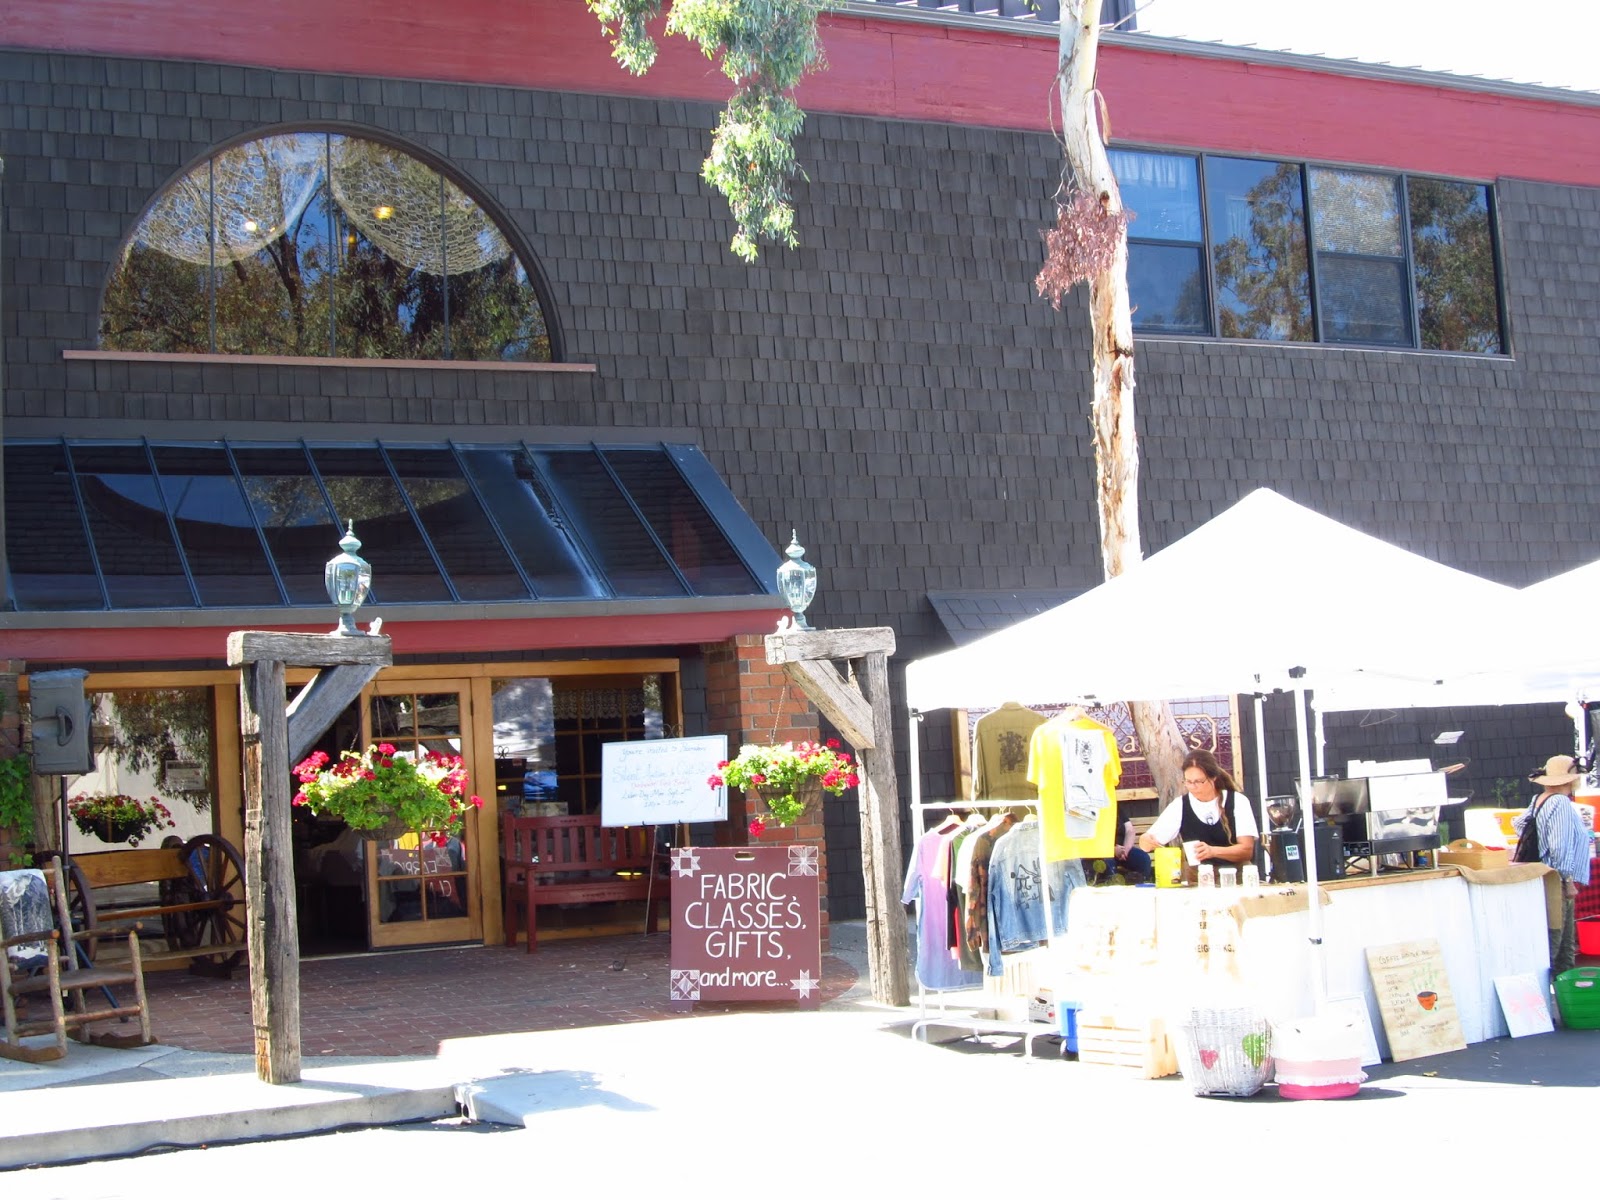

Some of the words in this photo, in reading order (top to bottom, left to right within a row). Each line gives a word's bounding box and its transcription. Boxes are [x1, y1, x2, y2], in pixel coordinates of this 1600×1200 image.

[701, 872, 796, 901] FABRIC,
[685, 902, 807, 929] CLASSES,
[705, 931, 791, 960] GIFTS,
[700, 966, 729, 987] and
